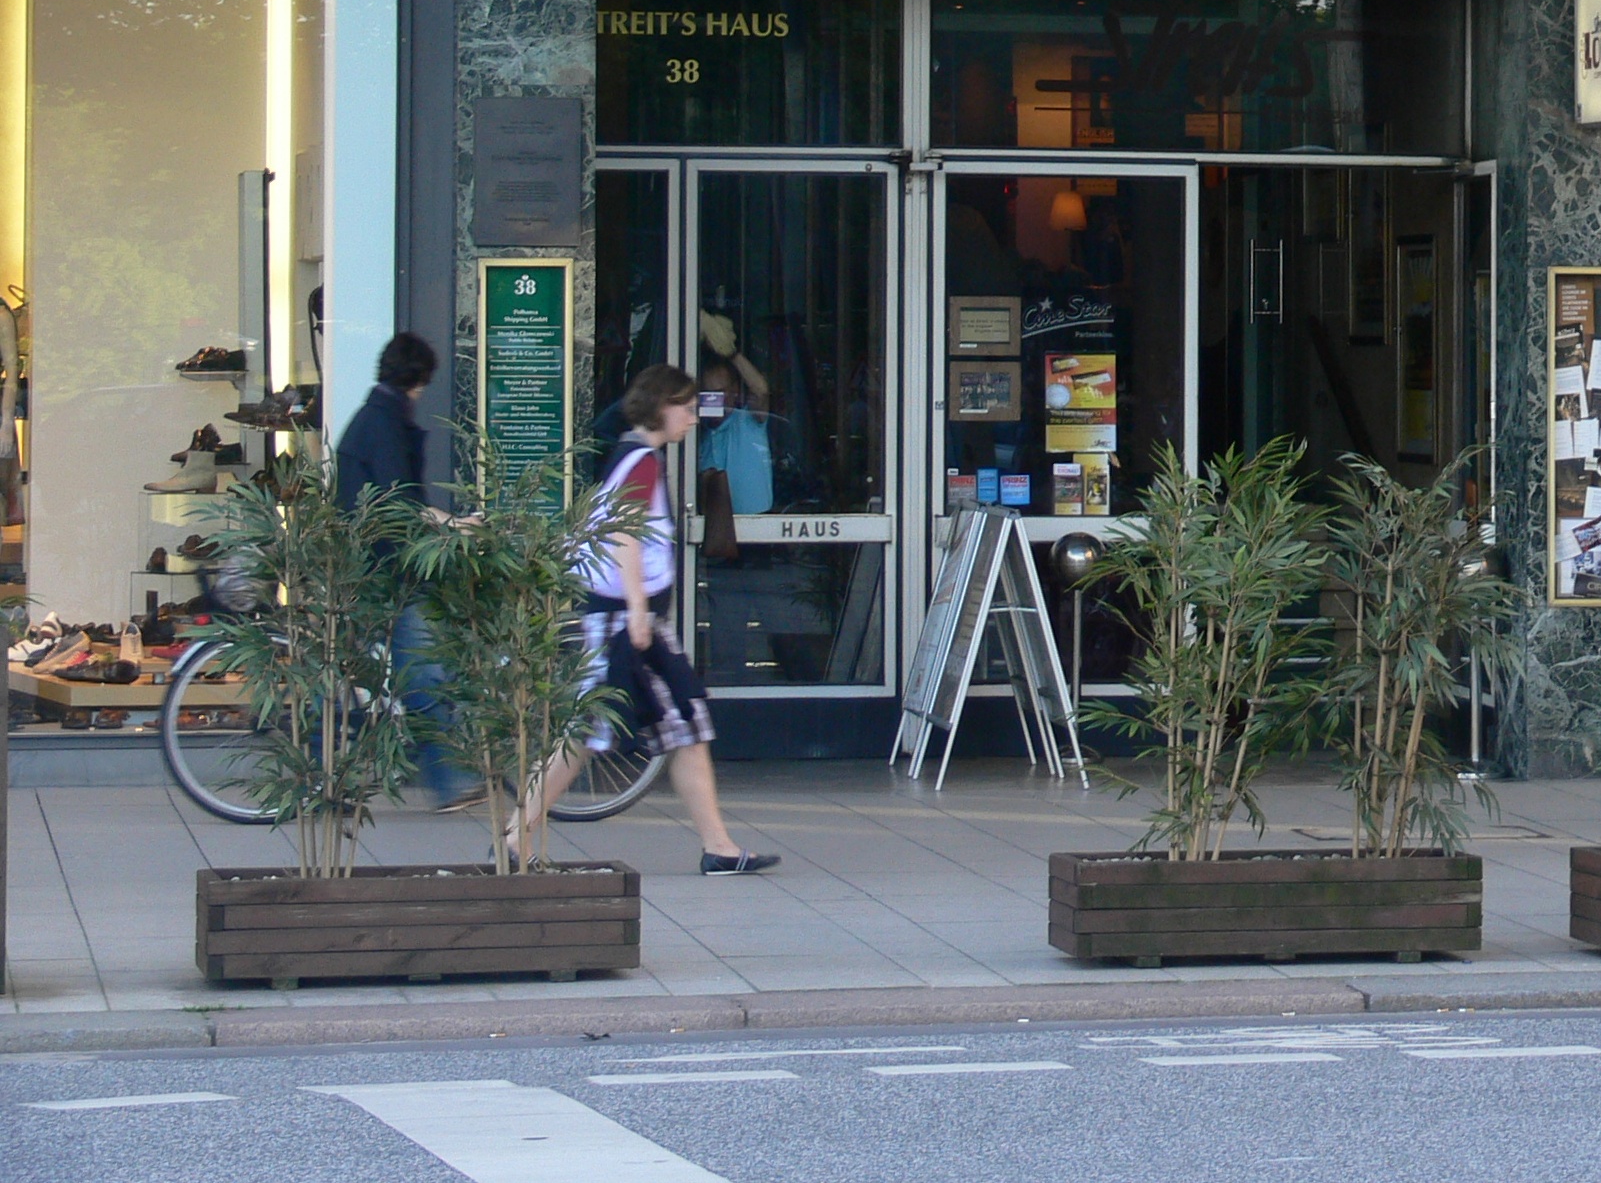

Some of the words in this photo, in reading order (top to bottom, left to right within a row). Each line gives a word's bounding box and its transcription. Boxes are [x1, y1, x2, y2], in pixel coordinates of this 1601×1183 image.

[596, 10, 697, 36] TREIT'S
[706, 12, 790, 38] HAUS
[665, 58, 700, 84] 38
[514, 279, 536, 295] 38
[782, 521, 840, 538] HAUS
